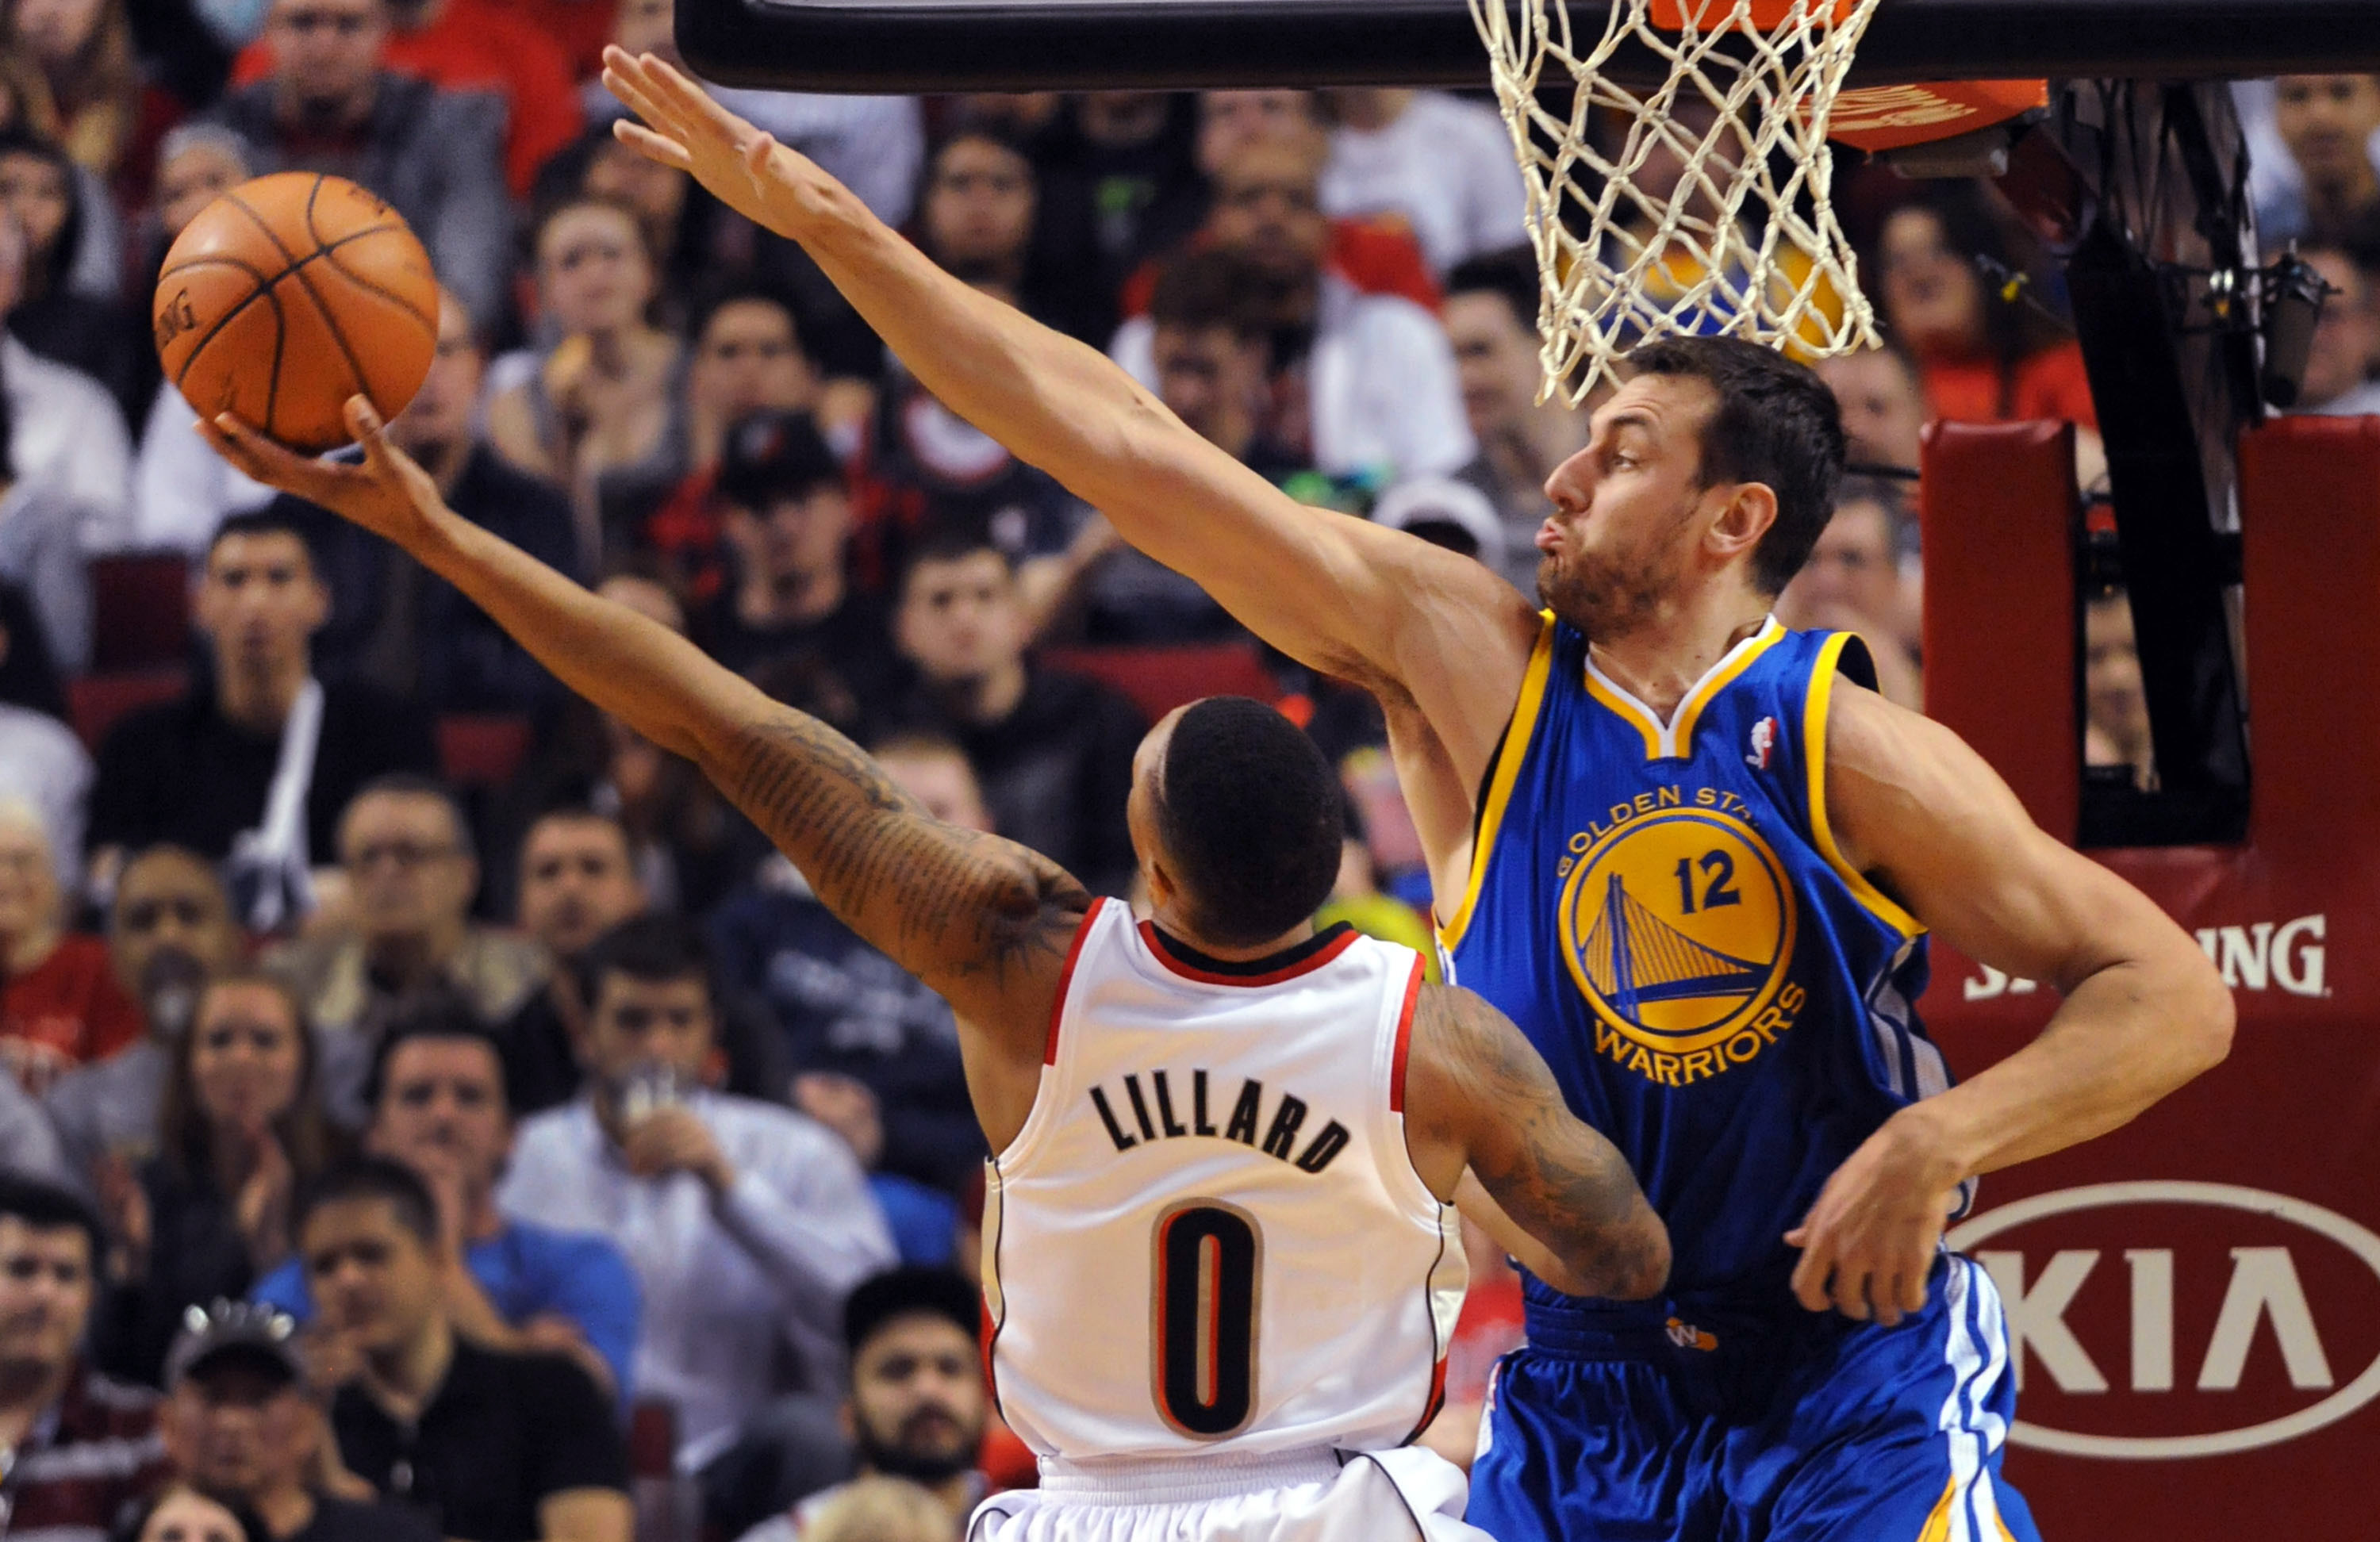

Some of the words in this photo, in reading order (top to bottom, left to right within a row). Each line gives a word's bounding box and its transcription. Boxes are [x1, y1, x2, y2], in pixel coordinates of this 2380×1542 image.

[1557, 784, 1680, 877] GOLDEN
[1695, 787, 1759, 827] STA
[1674, 849, 1741, 915] 12
[1595, 981, 1806, 1087] WARRIORS
[1088, 1068, 1353, 1174] LILLARD
[1150, 1196, 1265, 1442] 0
[1976, 1246, 2334, 1393] KIA
